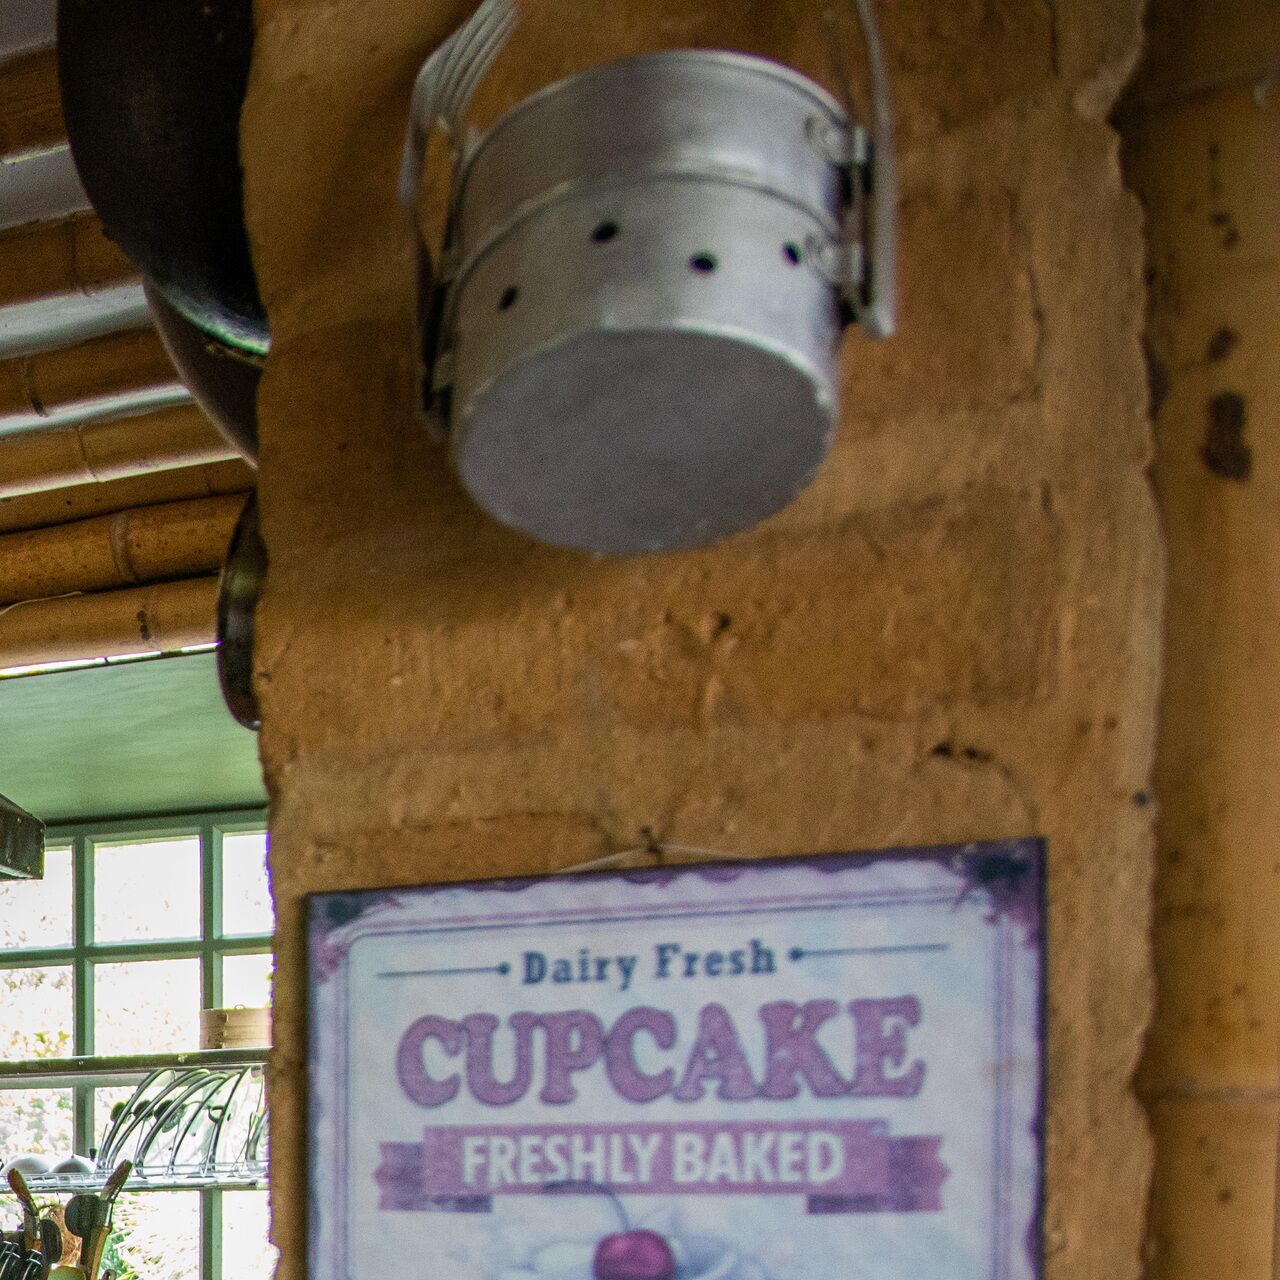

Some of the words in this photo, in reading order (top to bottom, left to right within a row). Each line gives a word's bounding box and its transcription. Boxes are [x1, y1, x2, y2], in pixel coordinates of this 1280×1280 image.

[522, 948, 637, 992] Dairy
[655, 938, 777, 979] Fresh
[395, 994, 926, 1109] CUPCAKE
[460, 1131, 665, 1188] FRESHLY
[672, 1130, 845, 1185] BAKED
